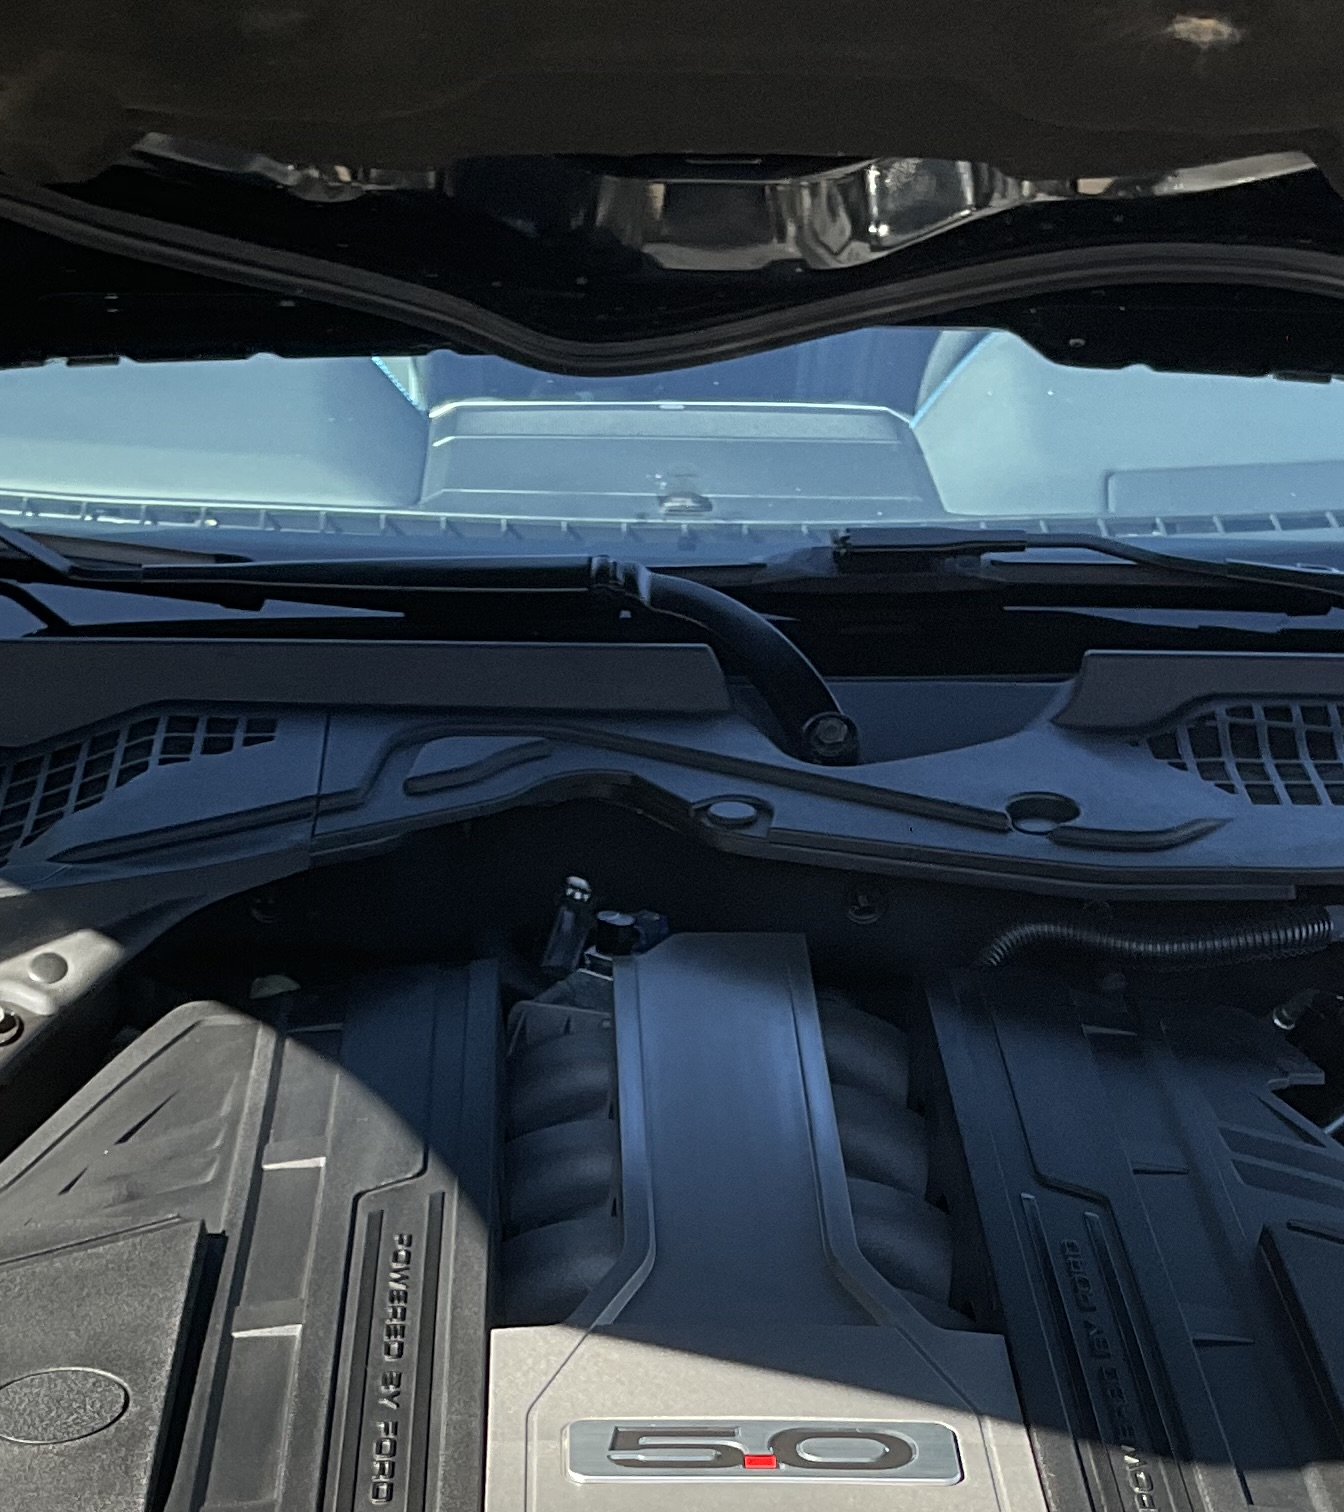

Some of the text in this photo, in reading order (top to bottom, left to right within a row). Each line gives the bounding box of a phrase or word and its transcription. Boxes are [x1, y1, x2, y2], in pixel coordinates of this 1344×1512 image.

[1060, 1239, 1097, 1313] FORD
[371, 1233, 413, 1504] POWERED BY FORD
[606, 1424, 918, 1470] 5.0
